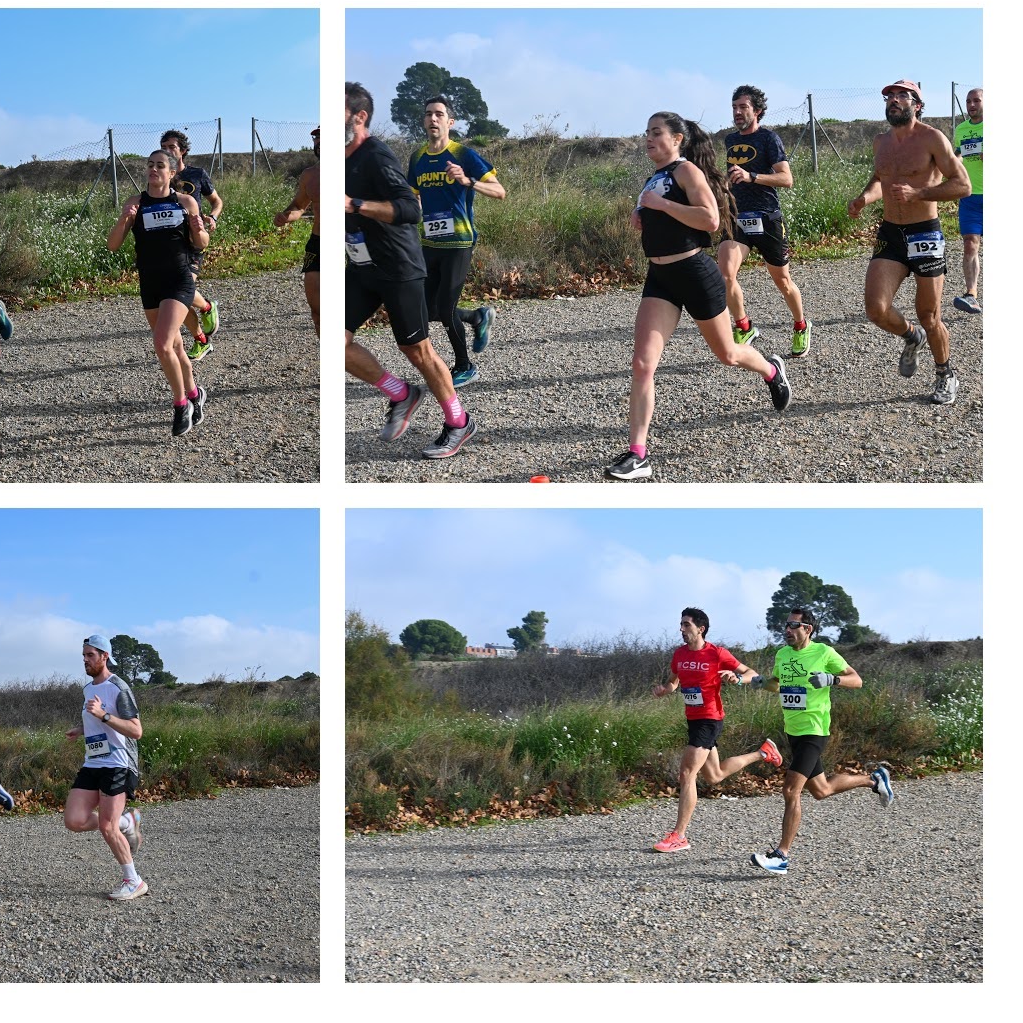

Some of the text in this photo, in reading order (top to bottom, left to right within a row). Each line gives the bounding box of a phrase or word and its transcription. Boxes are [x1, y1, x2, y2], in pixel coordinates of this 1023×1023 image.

[152, 210, 174, 219] 1102
[428, 220, 448, 231] 292
[914, 242, 938, 252] 192
[682, 661, 710, 671] CSIC
[783, 695, 801, 704] 300
